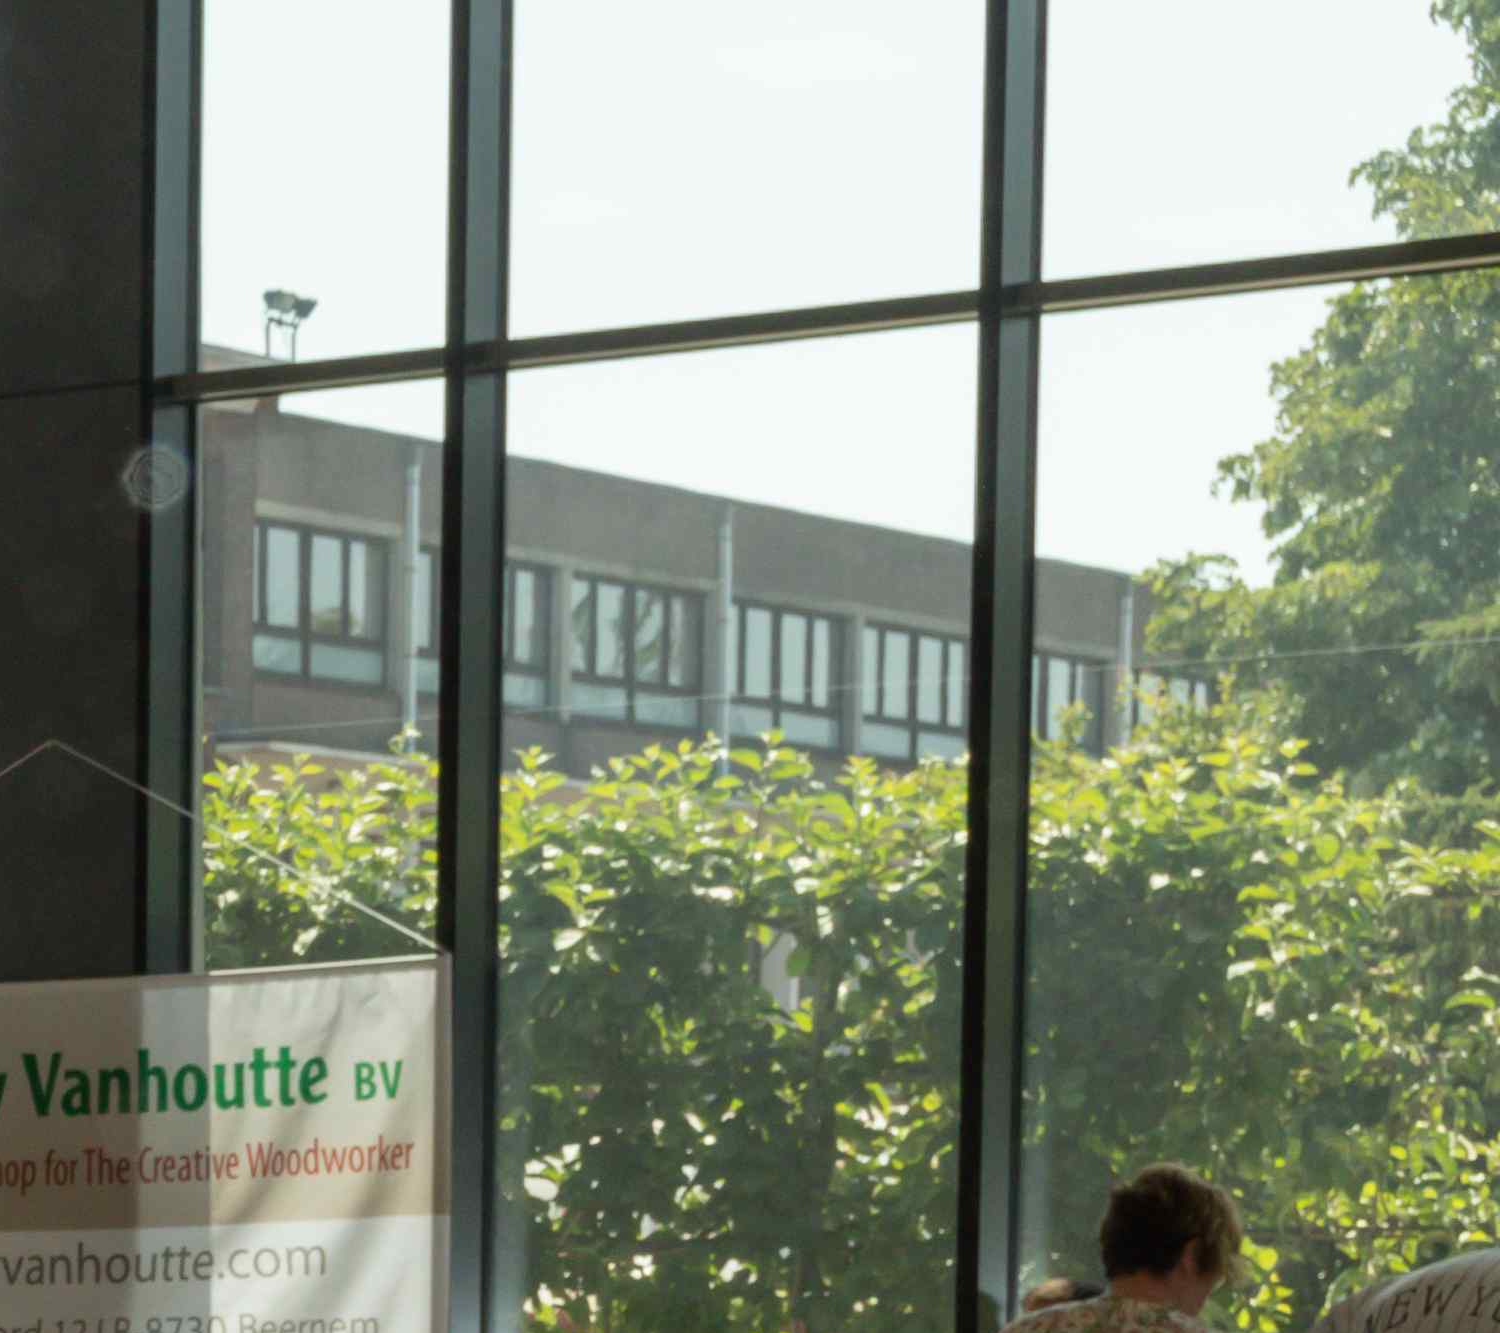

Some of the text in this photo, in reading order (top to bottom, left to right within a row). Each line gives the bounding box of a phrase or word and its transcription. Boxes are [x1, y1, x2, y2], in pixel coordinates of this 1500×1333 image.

[22, 1046, 329, 1118] Vanhoutte
[354, 1059, 404, 1101] BV
[44, 1149, 77, 1186] for
[83, 1147, 132, 1184] The
[138, 1144, 241, 1182] Creative
[245, 1137, 415, 1179] Woodworker
